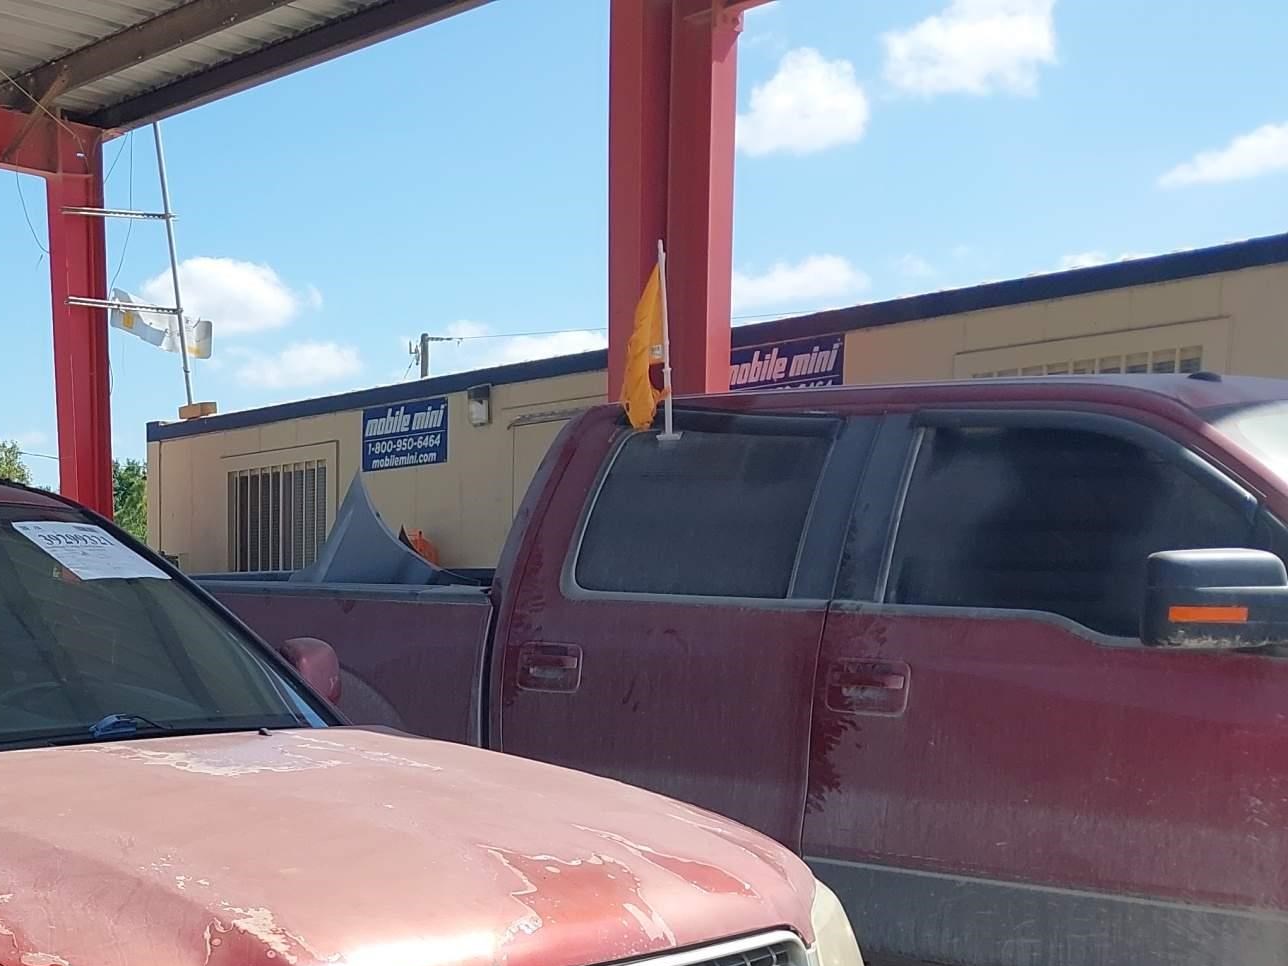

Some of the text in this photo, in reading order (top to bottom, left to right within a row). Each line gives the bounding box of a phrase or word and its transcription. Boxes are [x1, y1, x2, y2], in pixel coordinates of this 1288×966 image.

[789, 343, 840, 376] mini
[365, 404, 445, 437] mobile mini
[368, 433, 441, 455] 1-800-950-6464
[371, 452, 437, 469] mobilemini.com
